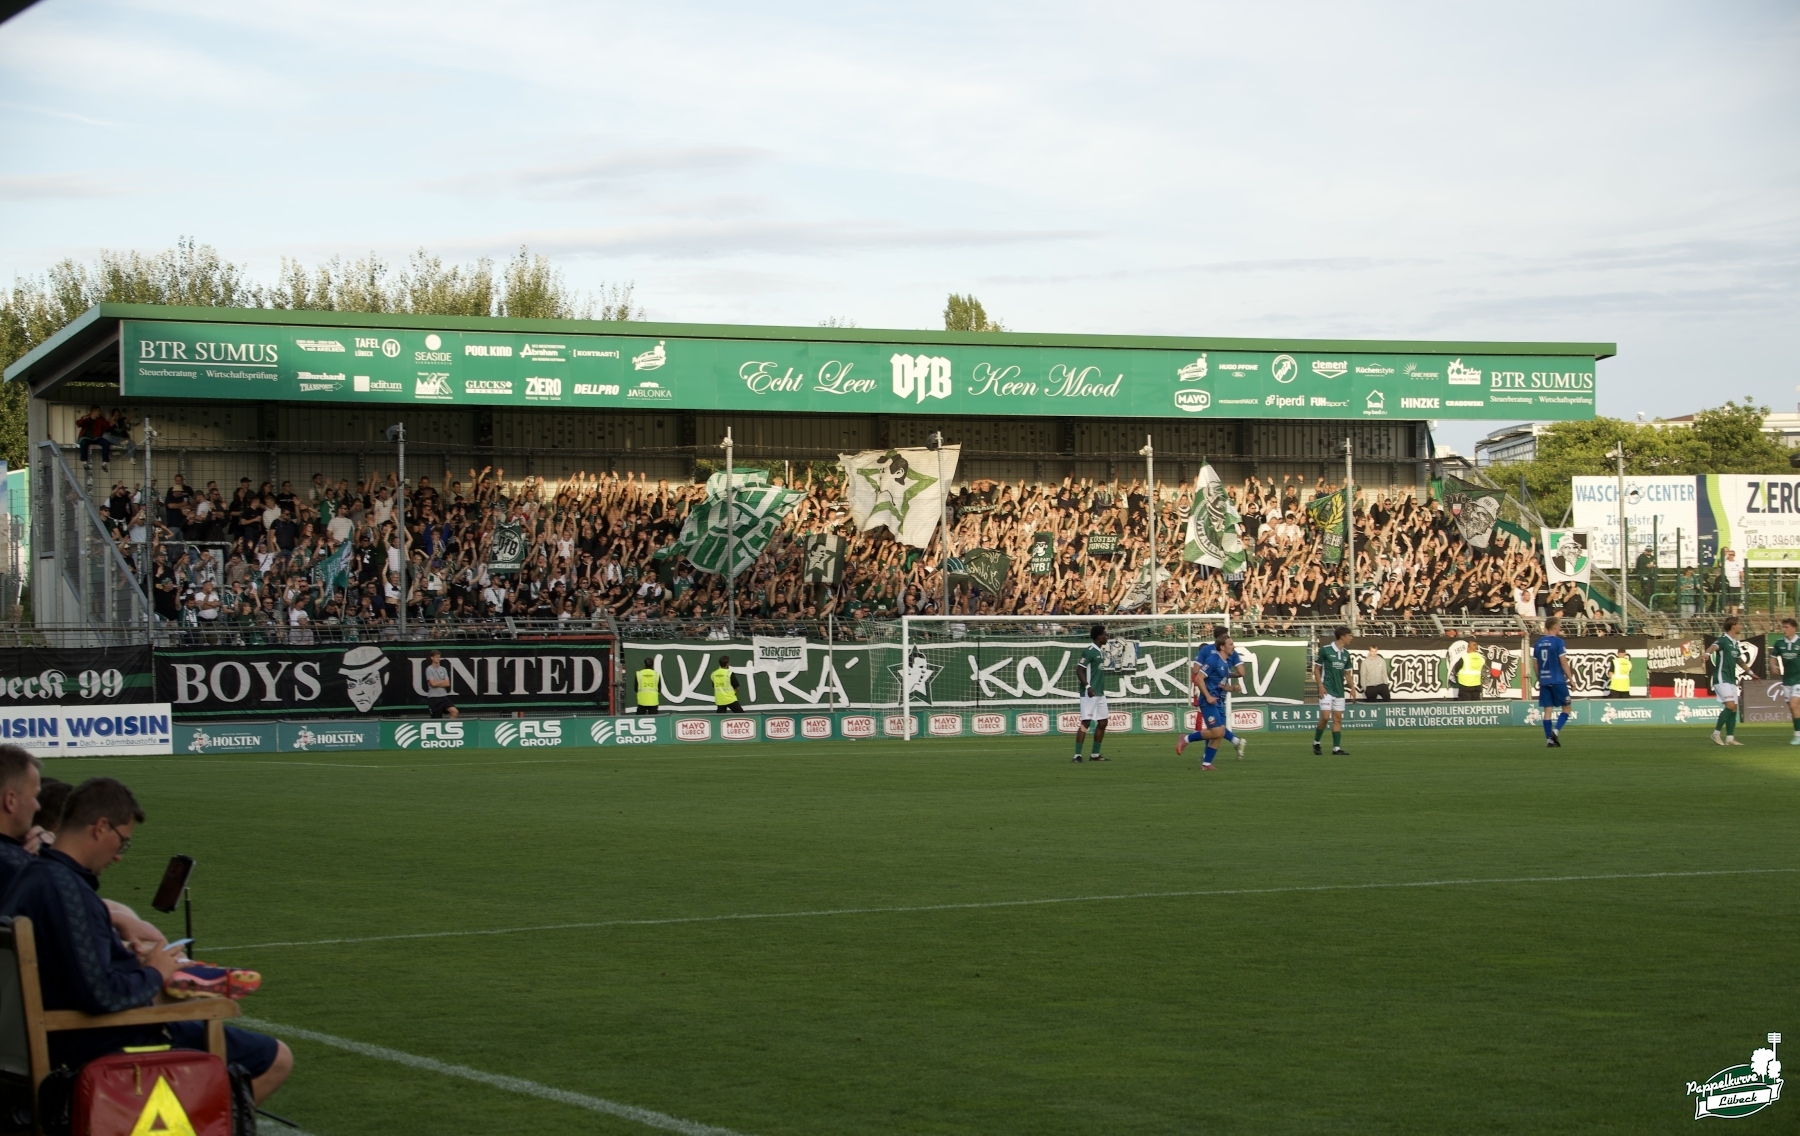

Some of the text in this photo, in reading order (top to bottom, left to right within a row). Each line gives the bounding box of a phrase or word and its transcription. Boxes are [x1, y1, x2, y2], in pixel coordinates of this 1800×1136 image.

[355, 337, 380, 349] TAFEL
[139, 340, 278, 363] BTR SUMUS
[415, 351, 452, 362] SEASIDE
[519, 343, 558, 358] Abraham
[1312, 360, 1348, 370] clement
[1355, 366, 1395, 376] Küchenstyle
[139, 368, 197, 379] Steuerberatung
[206, 369, 278, 381] Wirtschaftsprüfung
[738, 360, 803, 395] Echt
[890, 353, 952, 404] VfB
[968, 362, 1039, 398] Keen
[1044, 363, 1124, 398] Mood
[1490, 372, 1593, 389] BTR SUMUS
[573, 383, 620, 396] DELLPRO
[627, 389, 672, 398] JABLONKA
[1178, 394, 1207, 404] MAYO
[1276, 394, 1305, 408] iperdi
[1401, 397, 1440, 409] HINZKE
[1490, 395, 1533, 405] Steuerberatung
[1539, 395, 1593, 406] Wirtschaftsprüfung
[1575, 484, 1695, 502] WASCH CENTER
[1606, 514, 1653, 526] Zieelstr.
[1089, 535, 1118, 543] KÜSTEN
[1635, 530, 1670, 546] LÜBCK
[1088, 542, 1110, 550] JUNGS
[1541, 649, 1549, 668] 9
[78, 668, 123, 699] 99
[171, 655, 604, 704] BOYS UNITED
[1271, 709, 1377, 721] KENSITON
[1386, 705, 1510, 717] IHRE IMMOBILIENEXPERTEN
[1617, 709, 1652, 719] HOLSTEN
[1692, 708, 1723, 718] HOLSTE
[1749, 712, 1784, 722] GOURMET
[66, 715, 170, 737] WOISIN
[615, 717, 657, 736] FLS
[1386, 714, 1500, 727] IN DER LÜBECKER BUCHT.
[421, 722, 464, 739] FLS
[520, 720, 562, 738] FLS
[80, 739, 99, 748] Dach-
[106, 738, 157, 747] Dämmbaustoffe
[213, 736, 261, 747] HOLSTEN
[317, 734, 364, 744] HOLSTEN
[421, 739, 464, 749] GROUP
[520, 738, 562, 746] GROUP
[615, 735, 657, 744] GROUP
